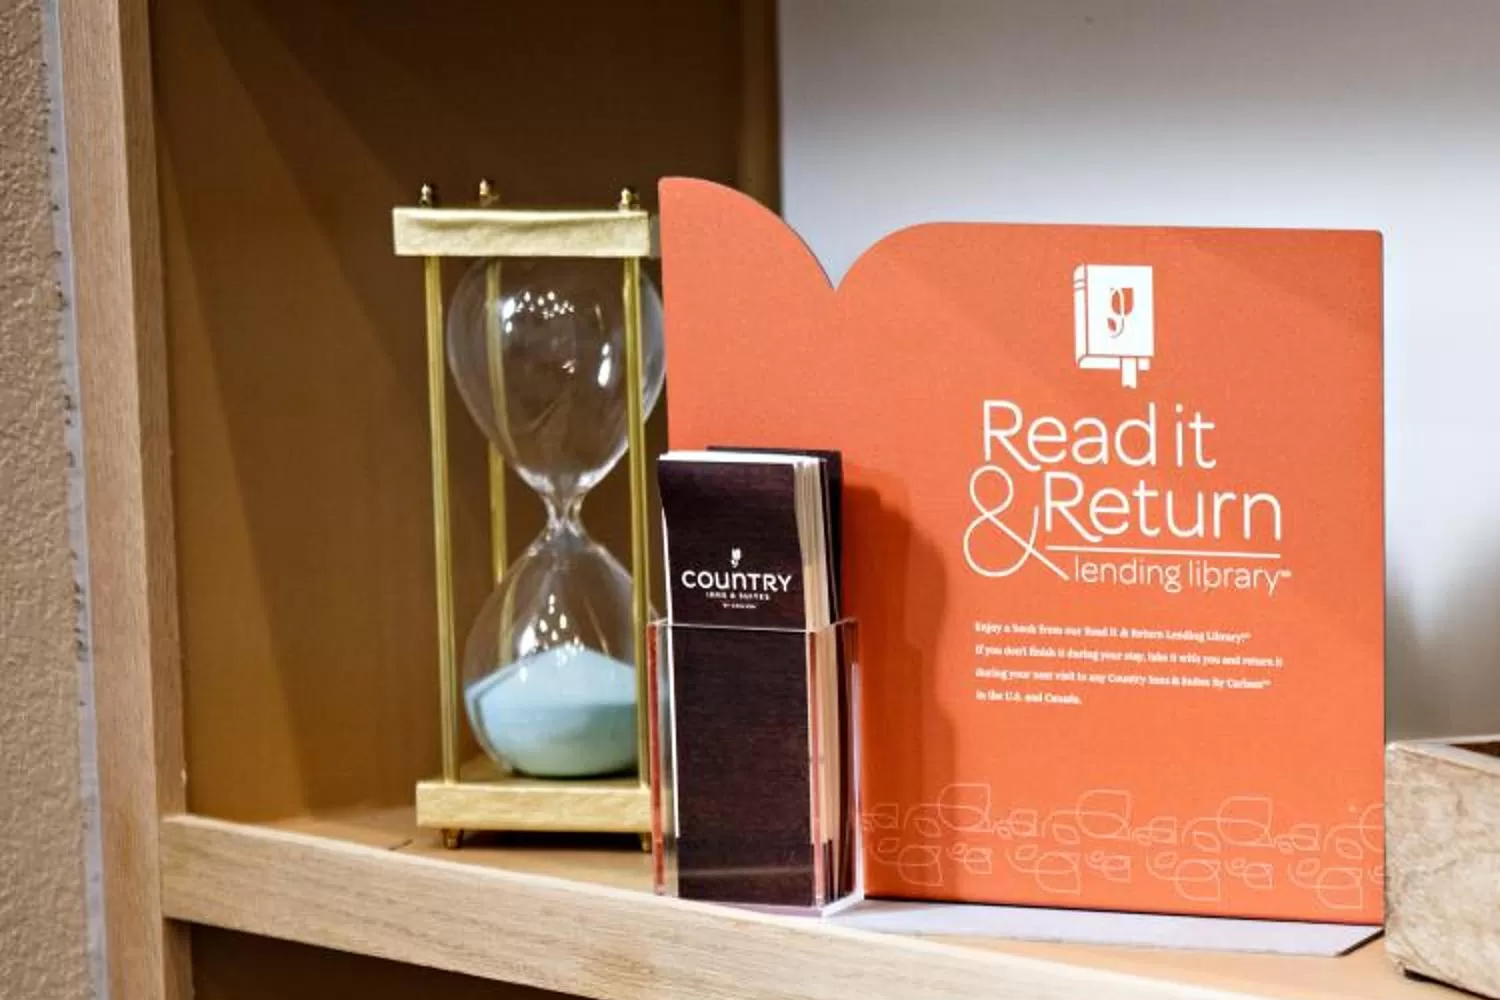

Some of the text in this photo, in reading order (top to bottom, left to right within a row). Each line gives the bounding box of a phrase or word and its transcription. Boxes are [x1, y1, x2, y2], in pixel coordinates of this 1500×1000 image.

[983, 399, 1217, 472] Read it
[963, 465, 1281, 581] & Return
[681, 569, 792, 593] COUNTRY
[1074, 554, 1183, 593] lending
[975, 621, 1002, 635] Enjoy
[1004, 625, 1011, 633] a
[1012, 623, 1037, 634] book
[1038, 624, 1063, 636] from
[1064, 627, 1081, 635] our
[1084, 626, 1108, 637] Read
[1120, 627, 1129, 638] &
[1131, 628, 1164, 640] Return
[1166, 630, 1205, 644] Lending
[975, 643, 985, 655] If
[985, 646, 1003, 658] you
[1004, 645, 1027, 656] don't
[1029, 645, 1056, 657] finish
[1058, 648, 1066, 657] it
[1067, 648, 1099, 662] during
[1100, 650, 1123, 662] your
[1148, 651, 1168, 662] take
[1169, 652, 1177, 662] it
[1179, 652, 1200, 664] with
[1202, 655, 1220, 667] you
[1221, 655, 1241, 665] and
[1242, 657, 1273, 667] return
[975, 667, 1007, 681] during
[1008, 670, 1030, 681] your
[1055, 671, 1074, 681] visit
[1077, 671, 1087, 681] to
[1089, 673, 1105, 685] any
[1107, 673, 1146, 687] Country
[1148, 675, 1169, 685] Inns
[1171, 676, 1180, 686] &
[1182, 676, 1210, 687] Suites
[975, 689, 987, 700] in
[988, 690, 1003, 701] the
[1024, 693, 1043, 703] and
